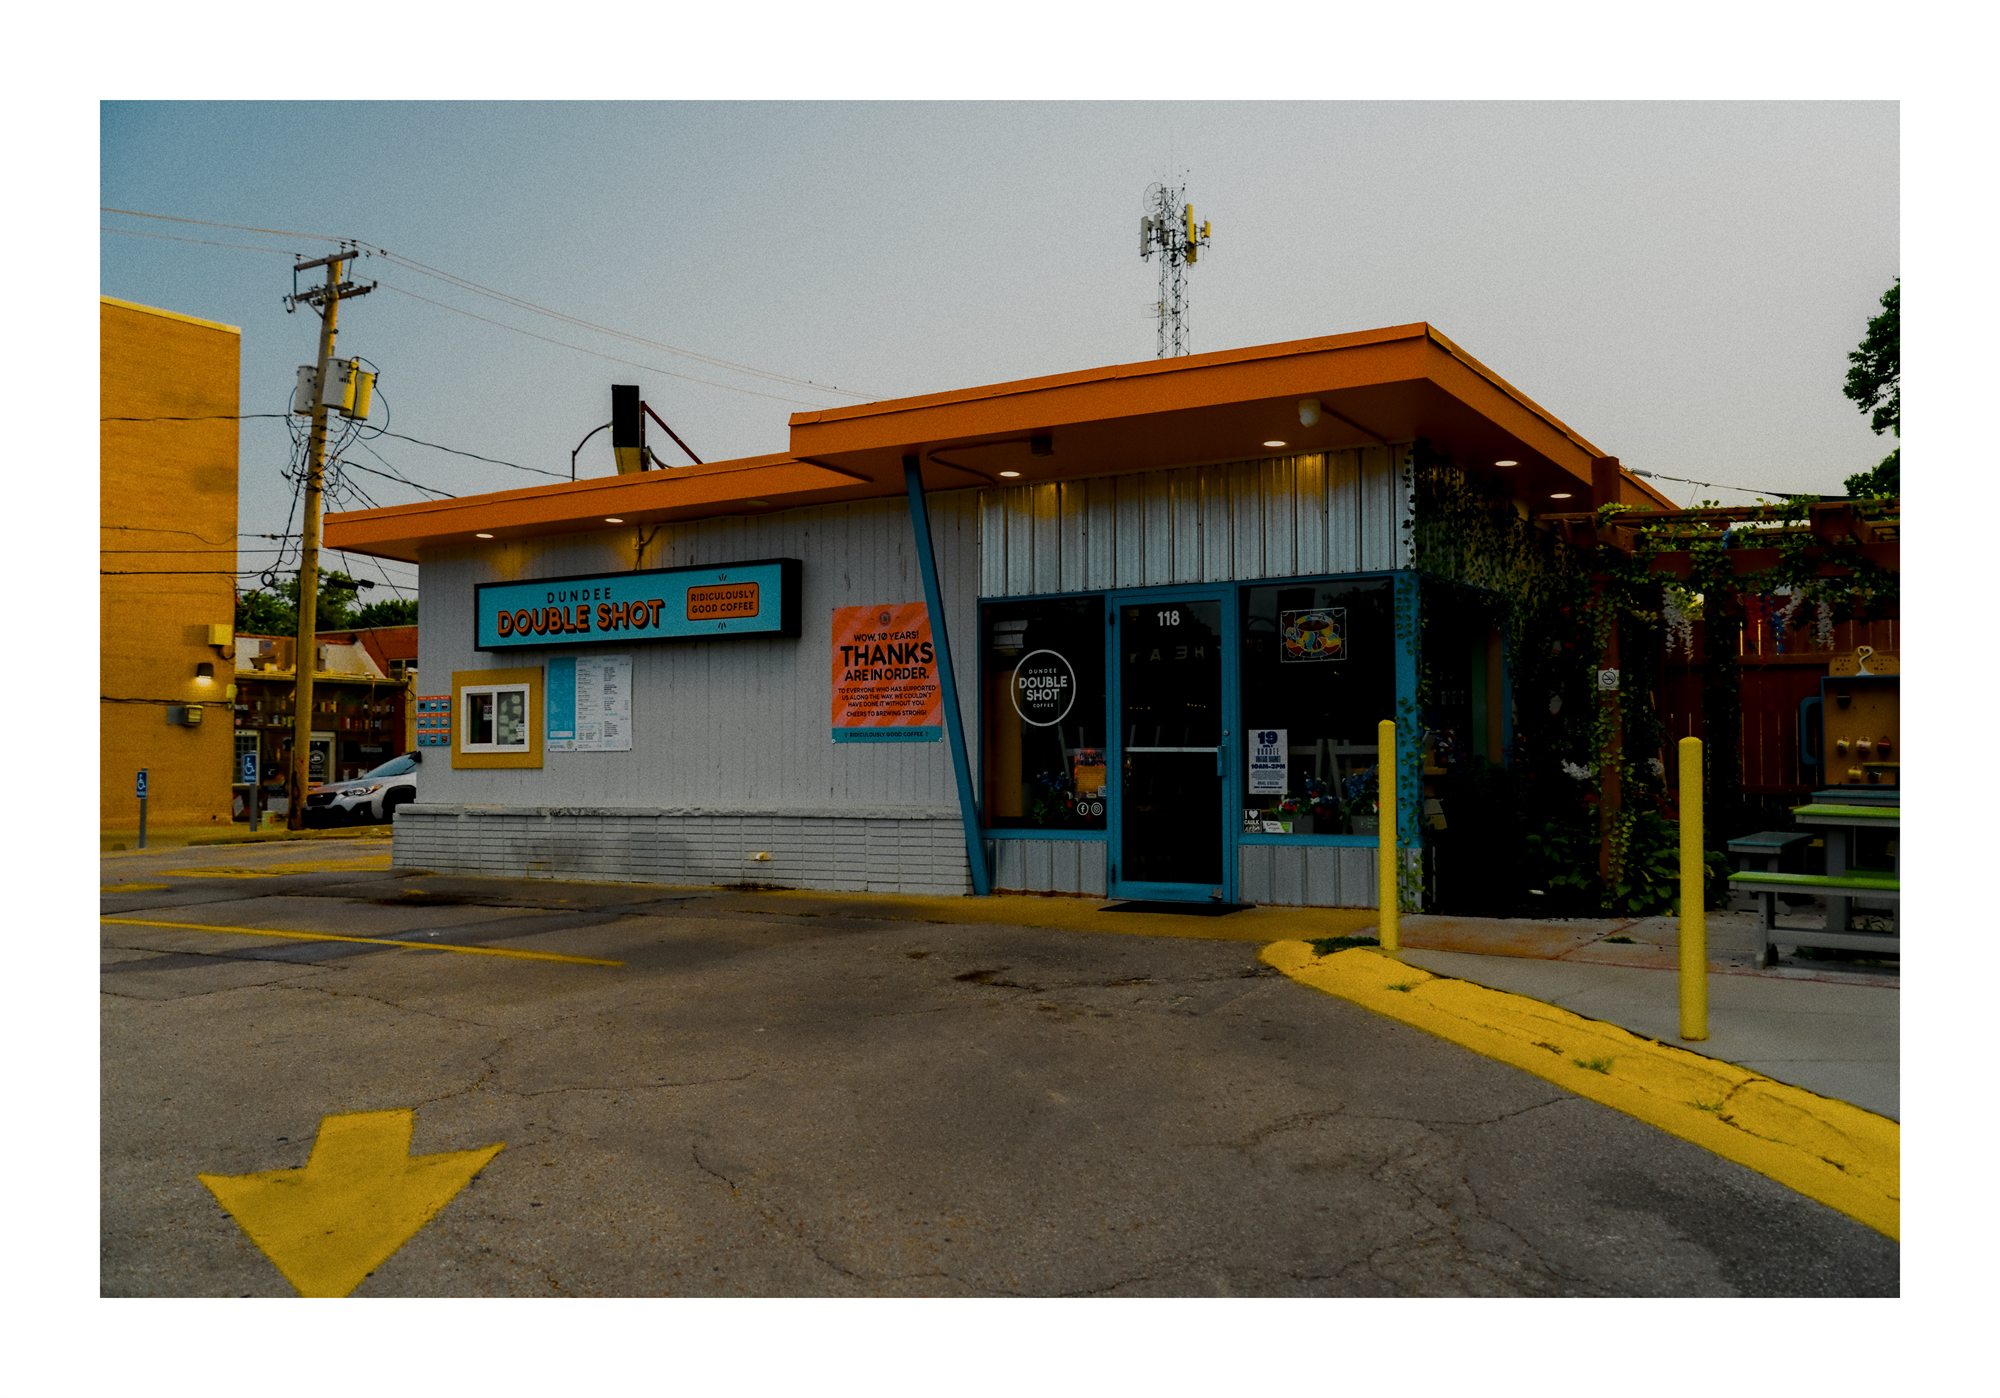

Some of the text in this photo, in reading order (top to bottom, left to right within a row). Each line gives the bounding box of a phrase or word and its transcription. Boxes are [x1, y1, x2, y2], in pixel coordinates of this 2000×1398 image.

[547, 587, 612, 603] DUNDEE
[690, 590, 755, 601] RIDICULOUSLY
[691, 602, 754, 613] GOOD COFFEE
[498, 598, 665, 637] DOUBLE SHOT
[1157, 610, 1180, 626] 118
[878, 632, 888, 641] 10
[889, 630, 919, 640] YEARS!
[840, 641, 934, 667] THANKS
[844, 667, 929, 681] ARE IN ORDER.
[903, 684, 936, 692] SUPPORTED
[1019, 675, 1068, 689] DOUBLE
[1026, 688, 1060, 701] SHOT
[1257, 731, 1278, 744] 19
